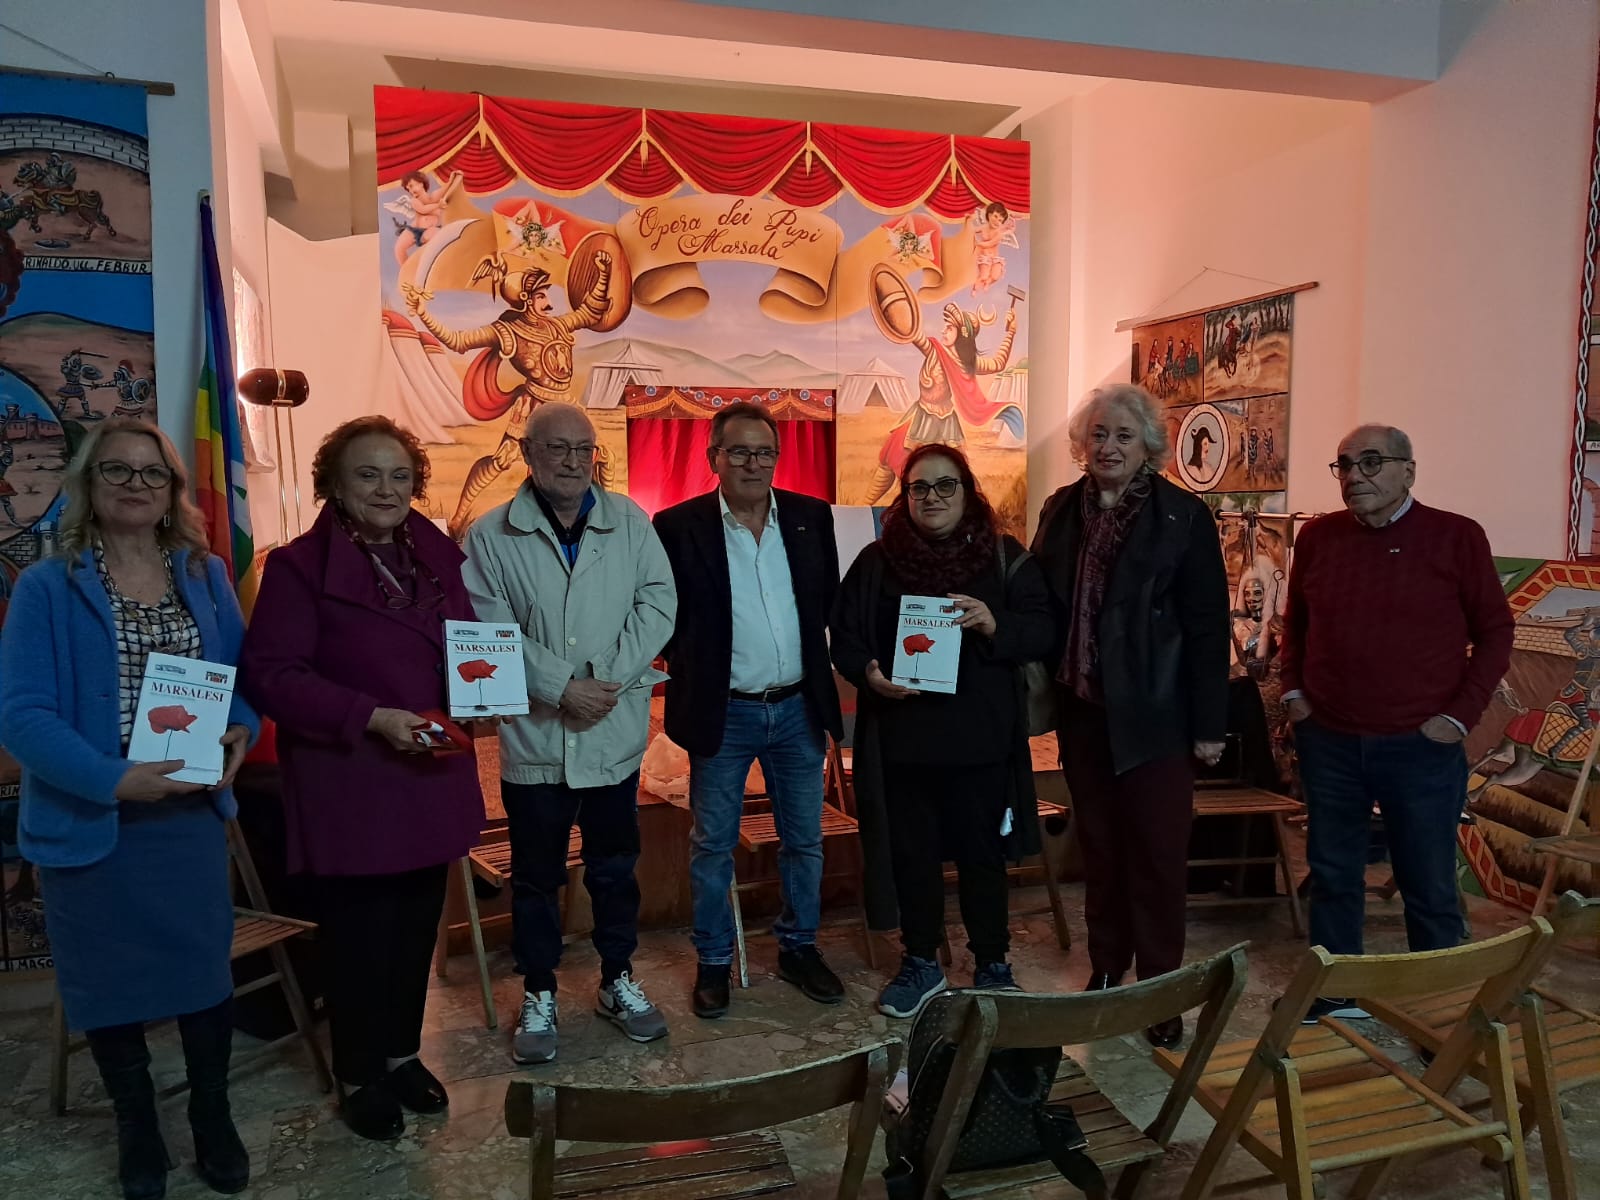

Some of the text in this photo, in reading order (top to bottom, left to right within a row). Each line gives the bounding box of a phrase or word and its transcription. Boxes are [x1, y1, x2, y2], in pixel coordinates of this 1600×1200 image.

[634, 199, 824, 250] Opera dei Pupi
[677, 228, 785, 260] Marsala
[904, 617, 954, 629] MARSALESI
[454, 643, 516, 653] MARSALESI
[152, 681, 224, 702] MARSALESI
